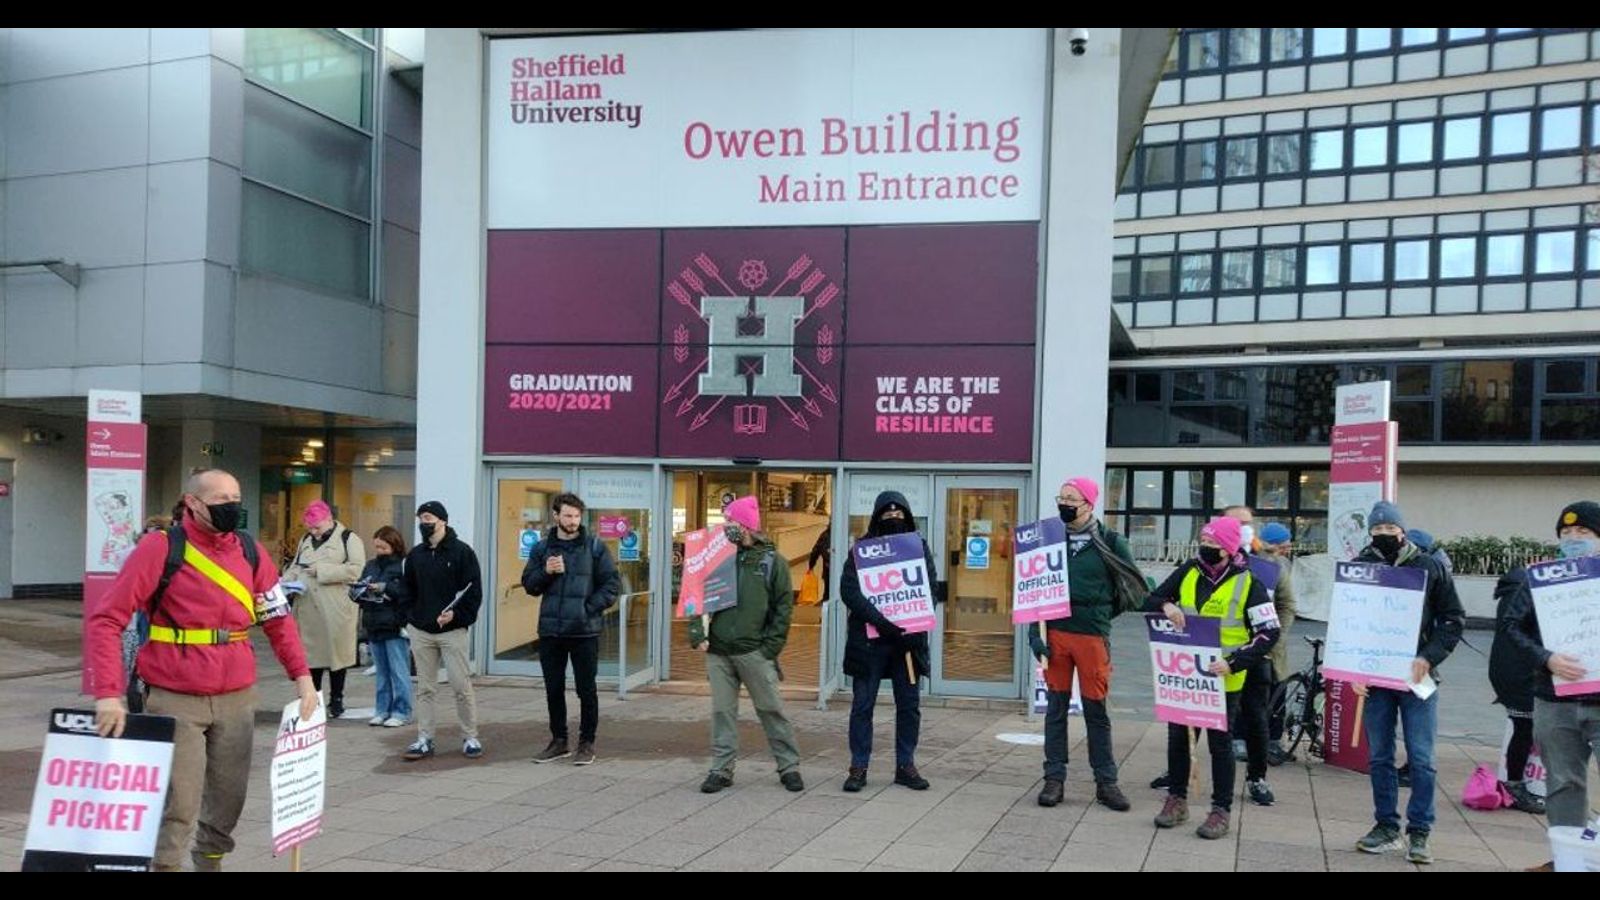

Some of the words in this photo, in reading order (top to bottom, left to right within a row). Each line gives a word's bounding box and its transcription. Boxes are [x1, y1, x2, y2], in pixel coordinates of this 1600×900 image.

[511, 54, 626, 79] Sheffield
[511, 79, 602, 102] Hallam
[511, 100, 643, 128] University
[684, 121, 807, 160] Owen
[820, 110, 1021, 163] Building
[758, 172, 846, 204] Main
[857, 171, 1019, 201] Entrance
[509, 374, 633, 392] GRADUATION
[876, 377, 907, 394] WE
[914, 377, 954, 394] ARE
[961, 377, 1000, 394] THE
[508, 393, 612, 412] 2020/2021
[876, 396, 940, 414] CLASS
[946, 396, 973, 414] OF
[875, 416, 994, 433] RESILIENCE
[1016, 527, 1038, 543] UCU
[859, 543, 891, 558] UCU
[1018, 550, 1063, 579] UCU
[1340, 566, 1375, 580] UCU
[1532, 562, 1580, 580] UCU
[864, 566, 924, 595] UCU
[1018, 574, 1064, 592] OFFICIAL
[868, 588, 926, 605] OFFICIAL
[1018, 585, 1066, 604] DISPUTE
[1151, 619, 1177, 632] UC
[1155, 649, 1218, 678] UCU
[1158, 674, 1219, 692] OFFICIAL
[1158, 687, 1221, 707] DISPUTE
[1329, 702, 1343, 754] Campus
[46, 758, 161, 793] OFFICIAL
[46, 798, 149, 831] PICKET
